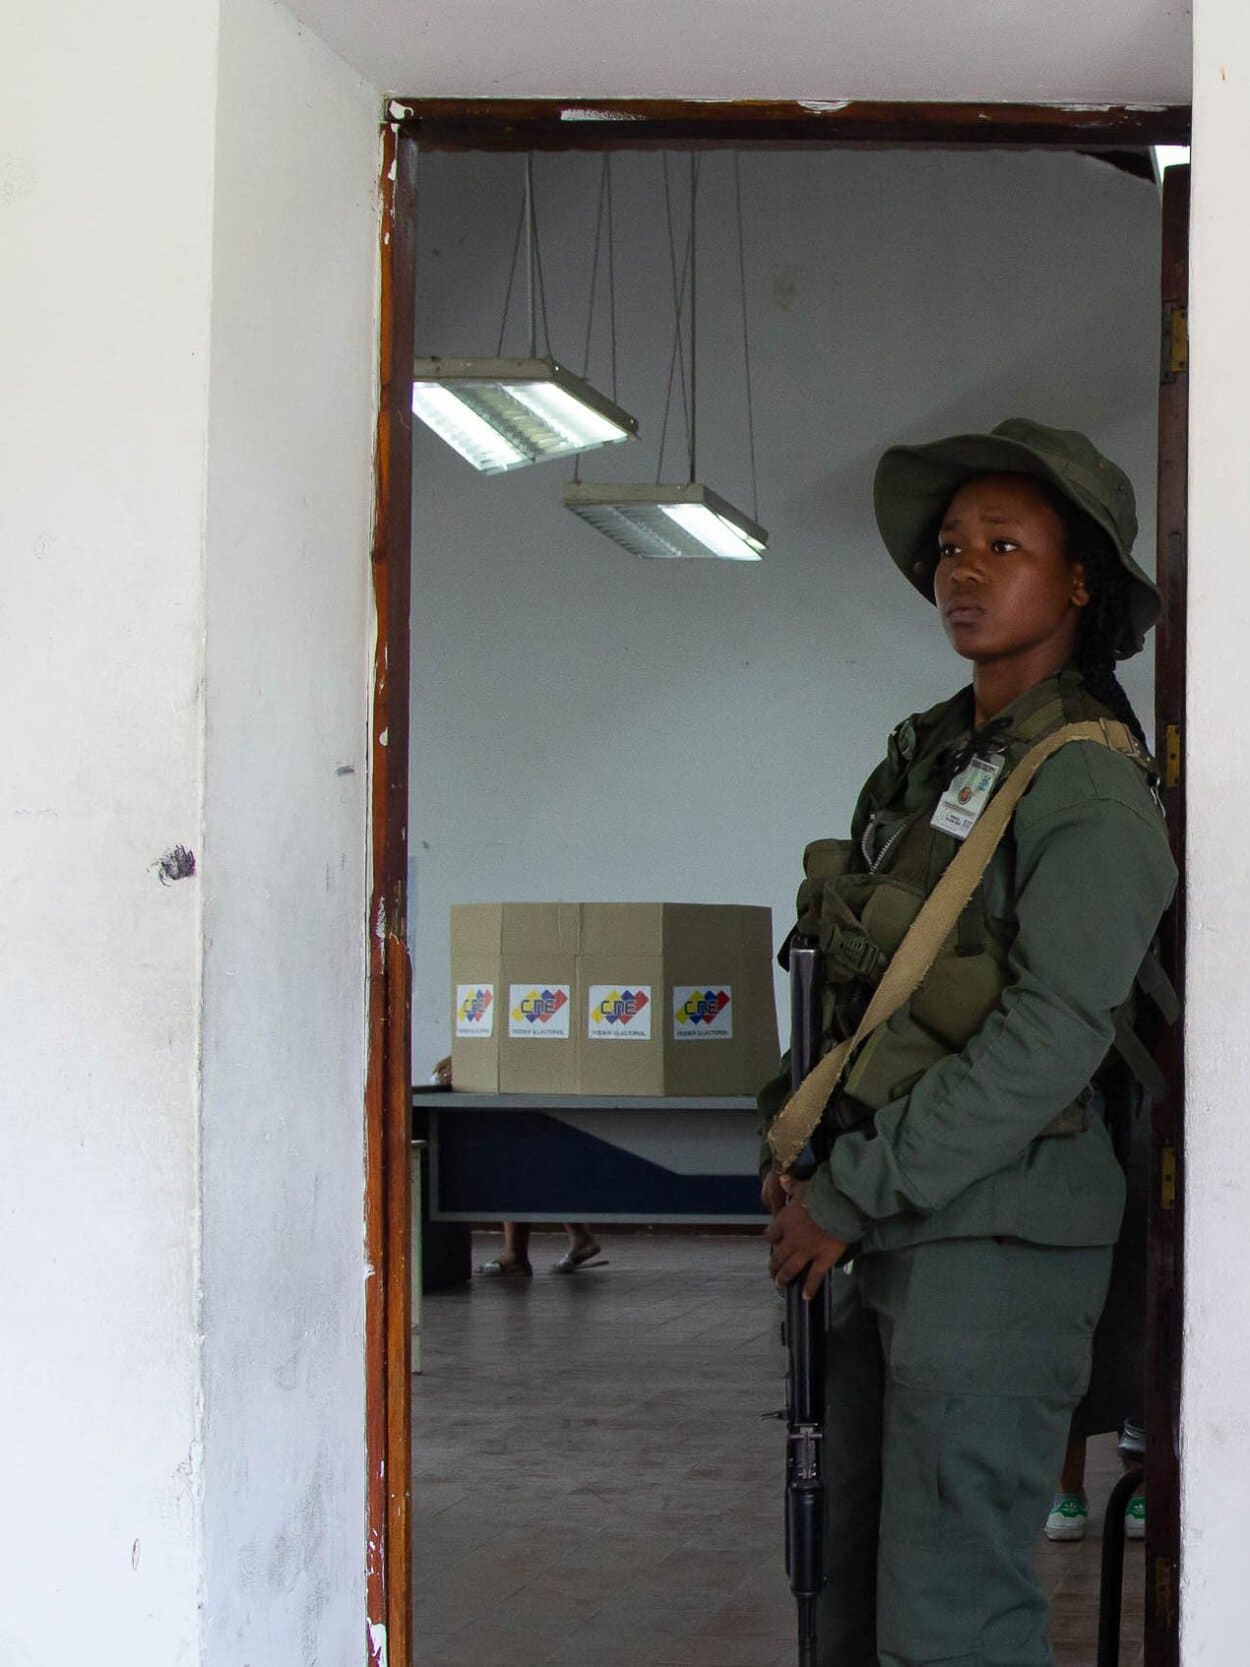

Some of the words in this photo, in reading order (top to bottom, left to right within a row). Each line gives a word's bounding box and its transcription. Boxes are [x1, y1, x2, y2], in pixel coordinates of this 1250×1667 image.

[520, 999, 557, 1014] CNE
[600, 1000, 637, 1015] CNE
[684, 1000, 720, 1015] CNE
